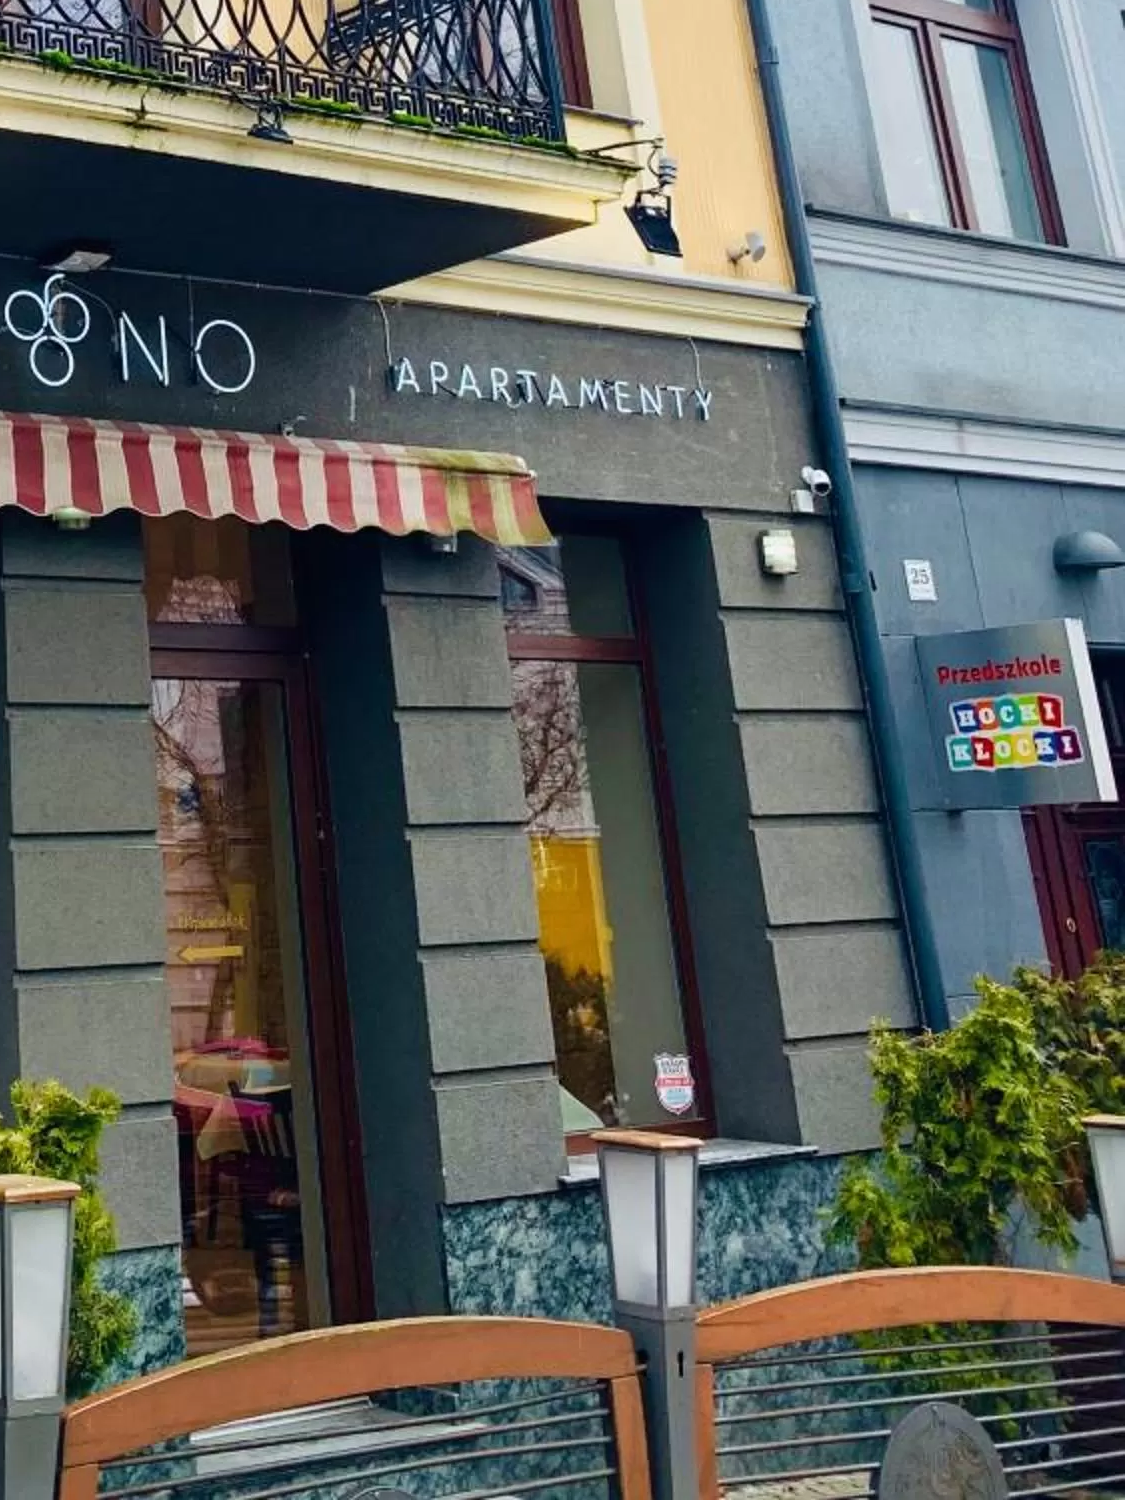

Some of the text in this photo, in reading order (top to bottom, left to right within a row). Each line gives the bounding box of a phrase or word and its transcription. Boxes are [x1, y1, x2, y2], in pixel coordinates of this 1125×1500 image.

[393, 356, 713, 422] APARTAMENTY
[910, 567, 930, 585] 25
[937, 653, 1063, 685] Przedszkole
[956, 701, 1057, 728] HOCKI
[952, 734, 1075, 762] KLOCKI
